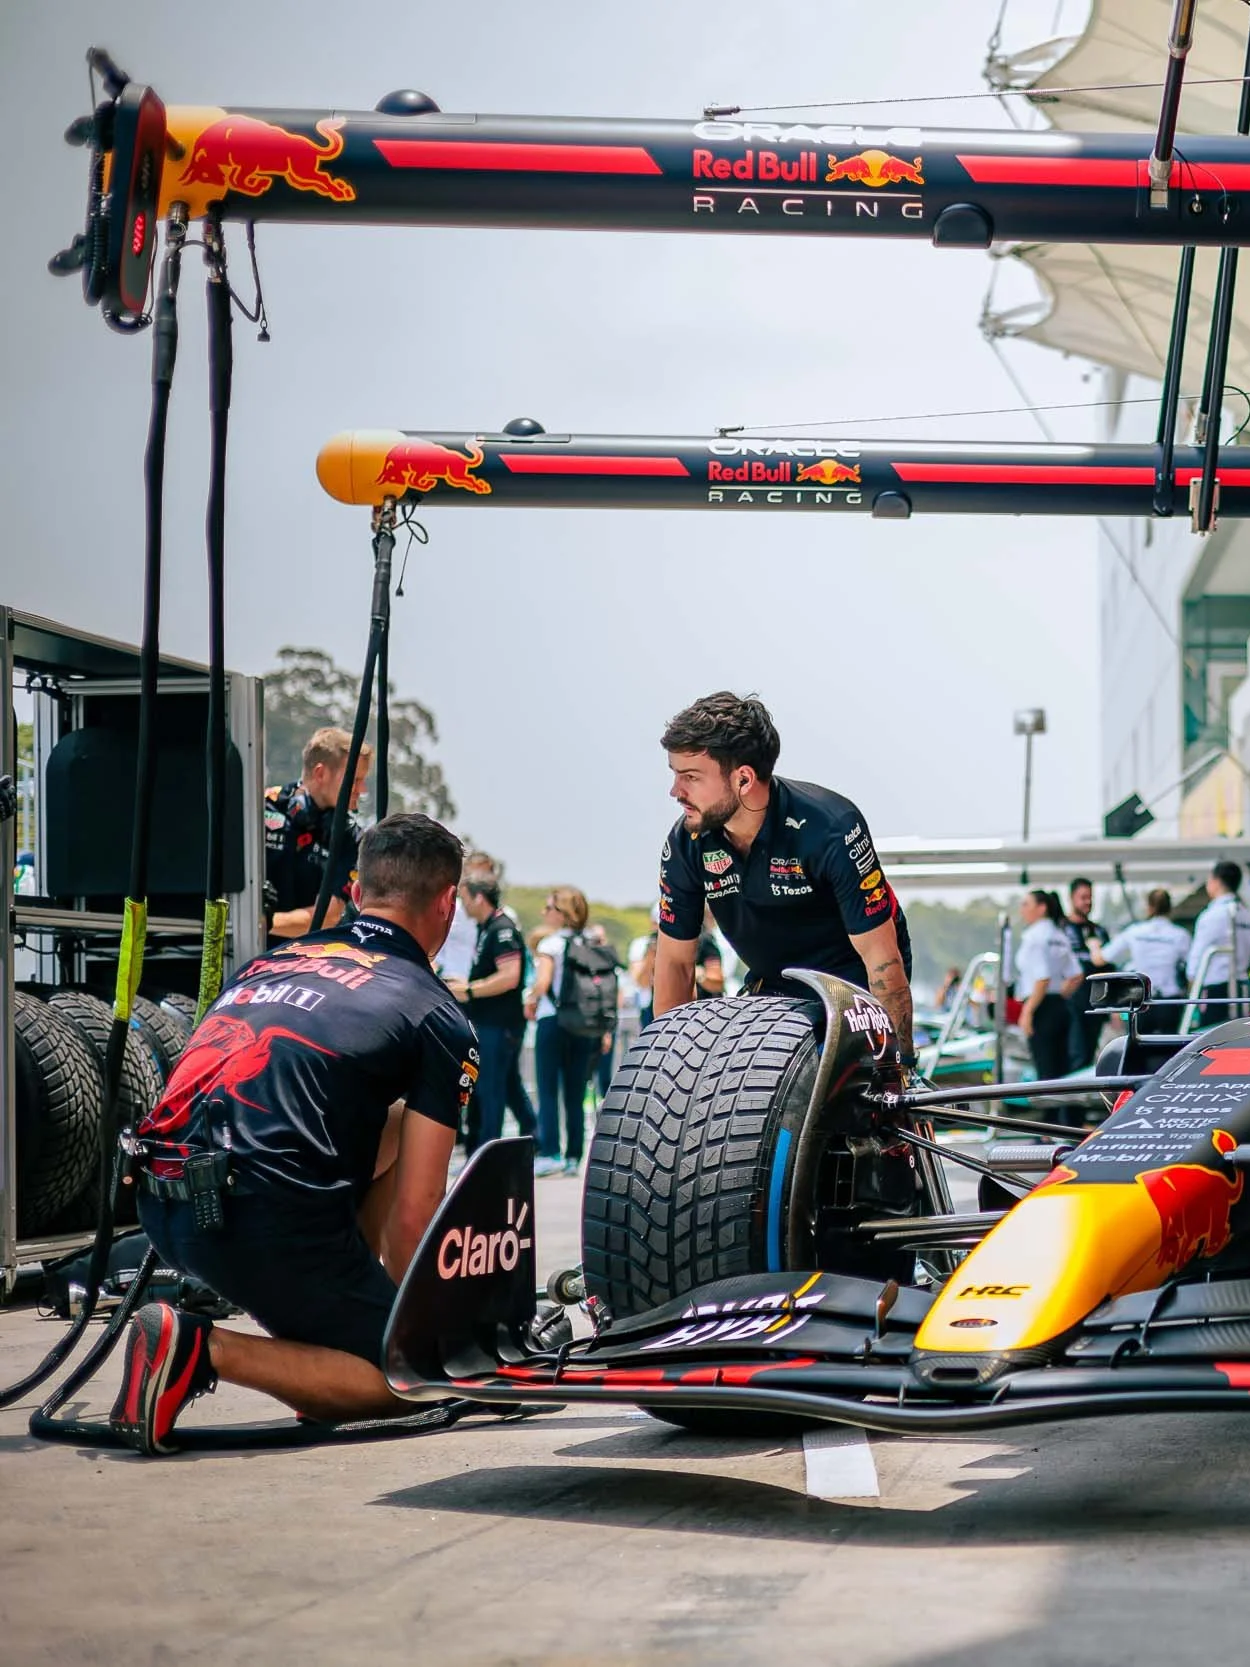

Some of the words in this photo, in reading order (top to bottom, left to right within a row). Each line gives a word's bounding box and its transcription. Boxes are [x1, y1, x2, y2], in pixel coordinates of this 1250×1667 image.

[692, 148, 753, 179] Red
[758, 150, 817, 182] Bull
[693, 195, 923, 219] RACING
[708, 460, 749, 481] Red
[751, 461, 791, 482] Bull
[708, 490, 862, 504] RACING
[704, 875, 734, 892] Mobil
[781, 885, 813, 896] Tezos
[707, 886, 740, 900] ORACL
[214, 983, 292, 1011] Mobil
[1160, 1082, 1211, 1091] Cash
[1161, 1106, 1233, 1115] Tezos
[1152, 1117, 1222, 1125] ARCTIC
[1157, 1122, 1210, 1130] WOLF
[1073, 1153, 1153, 1162] Mobil
[438, 1227, 520, 1280] Claro
[960, 1286, 1031, 1297] HRC
